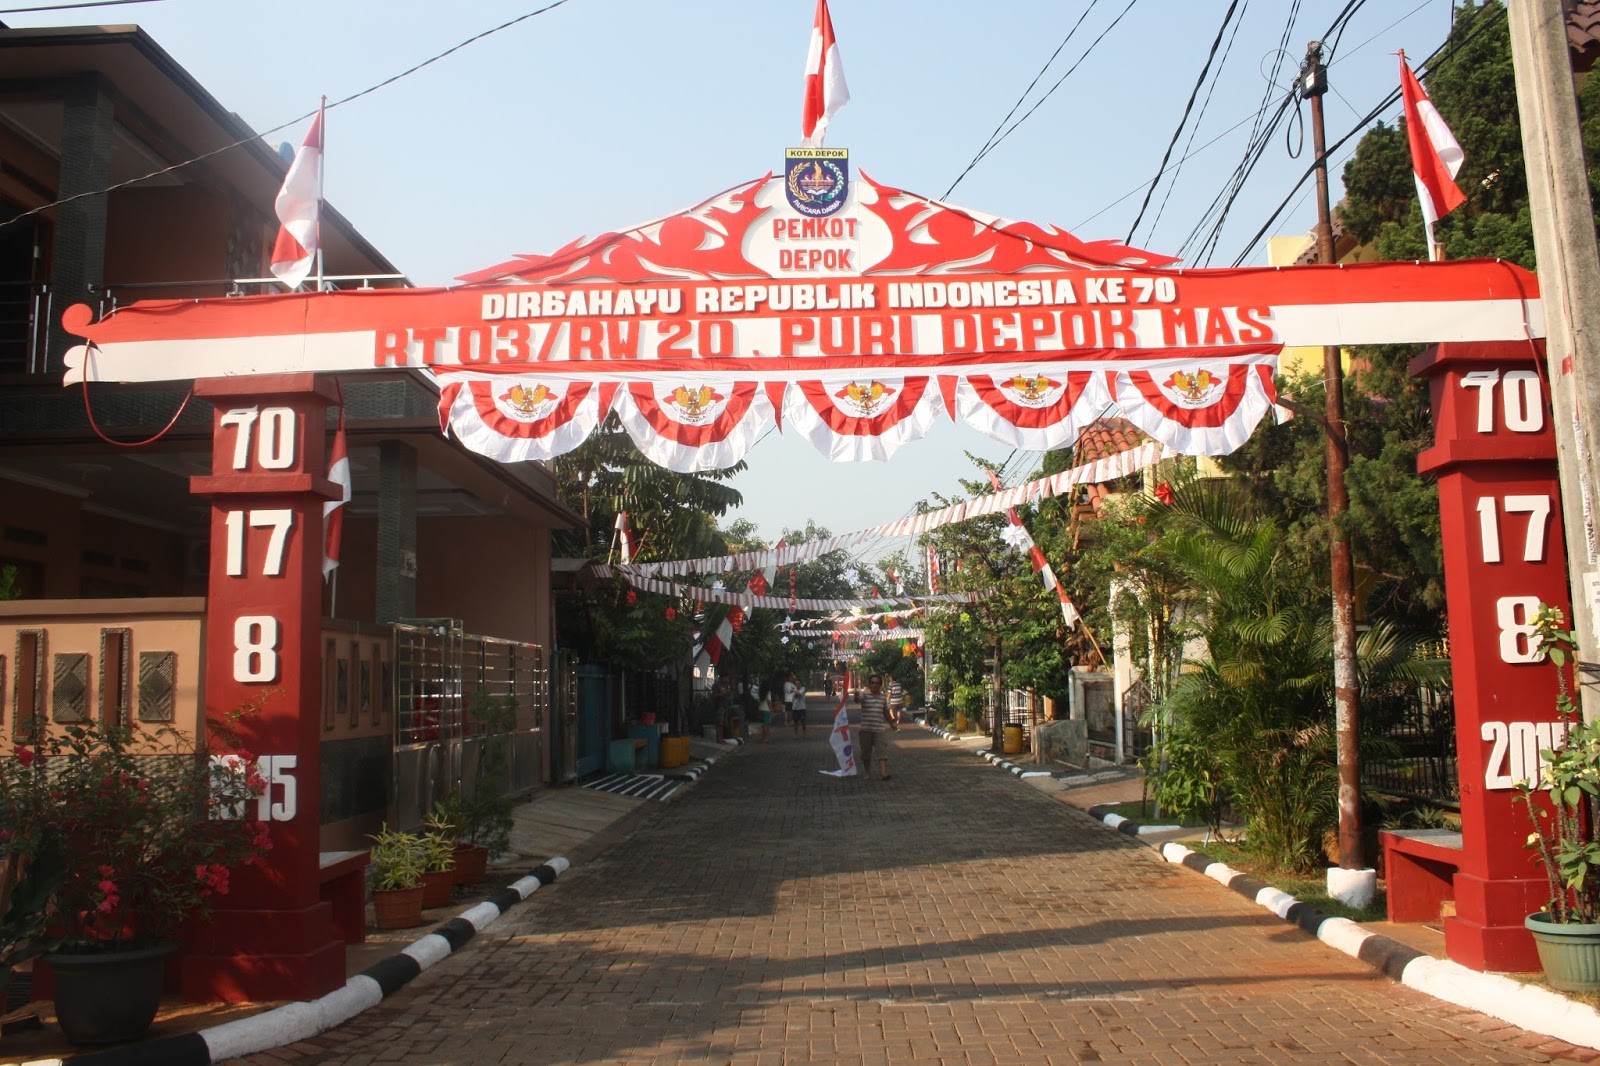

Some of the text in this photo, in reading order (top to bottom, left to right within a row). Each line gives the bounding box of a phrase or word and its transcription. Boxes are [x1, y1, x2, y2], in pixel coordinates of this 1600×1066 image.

[773, 218, 858, 240] PEMKOT
[792, 199, 842, 215] PARICARA DARMA
[779, 248, 852, 270] DEPOK
[695, 283, 875, 313] REPUBLIK
[888, 279, 1077, 308] INDONESIA
[1085, 277, 1127, 304] KE
[1131, 277, 1176, 302] 70
[780, 315, 914, 356] PURI
[941, 309, 1138, 354] DEPOK
[1160, 305, 1274, 346] MAS
[1459, 367, 1544, 433] 70
[220, 404, 296, 470] 70
[225, 508, 293, 576] 17
[1476, 494, 1551, 563] 17
[233, 615, 278, 683] 8
[1496, 595, 1546, 664] 8
